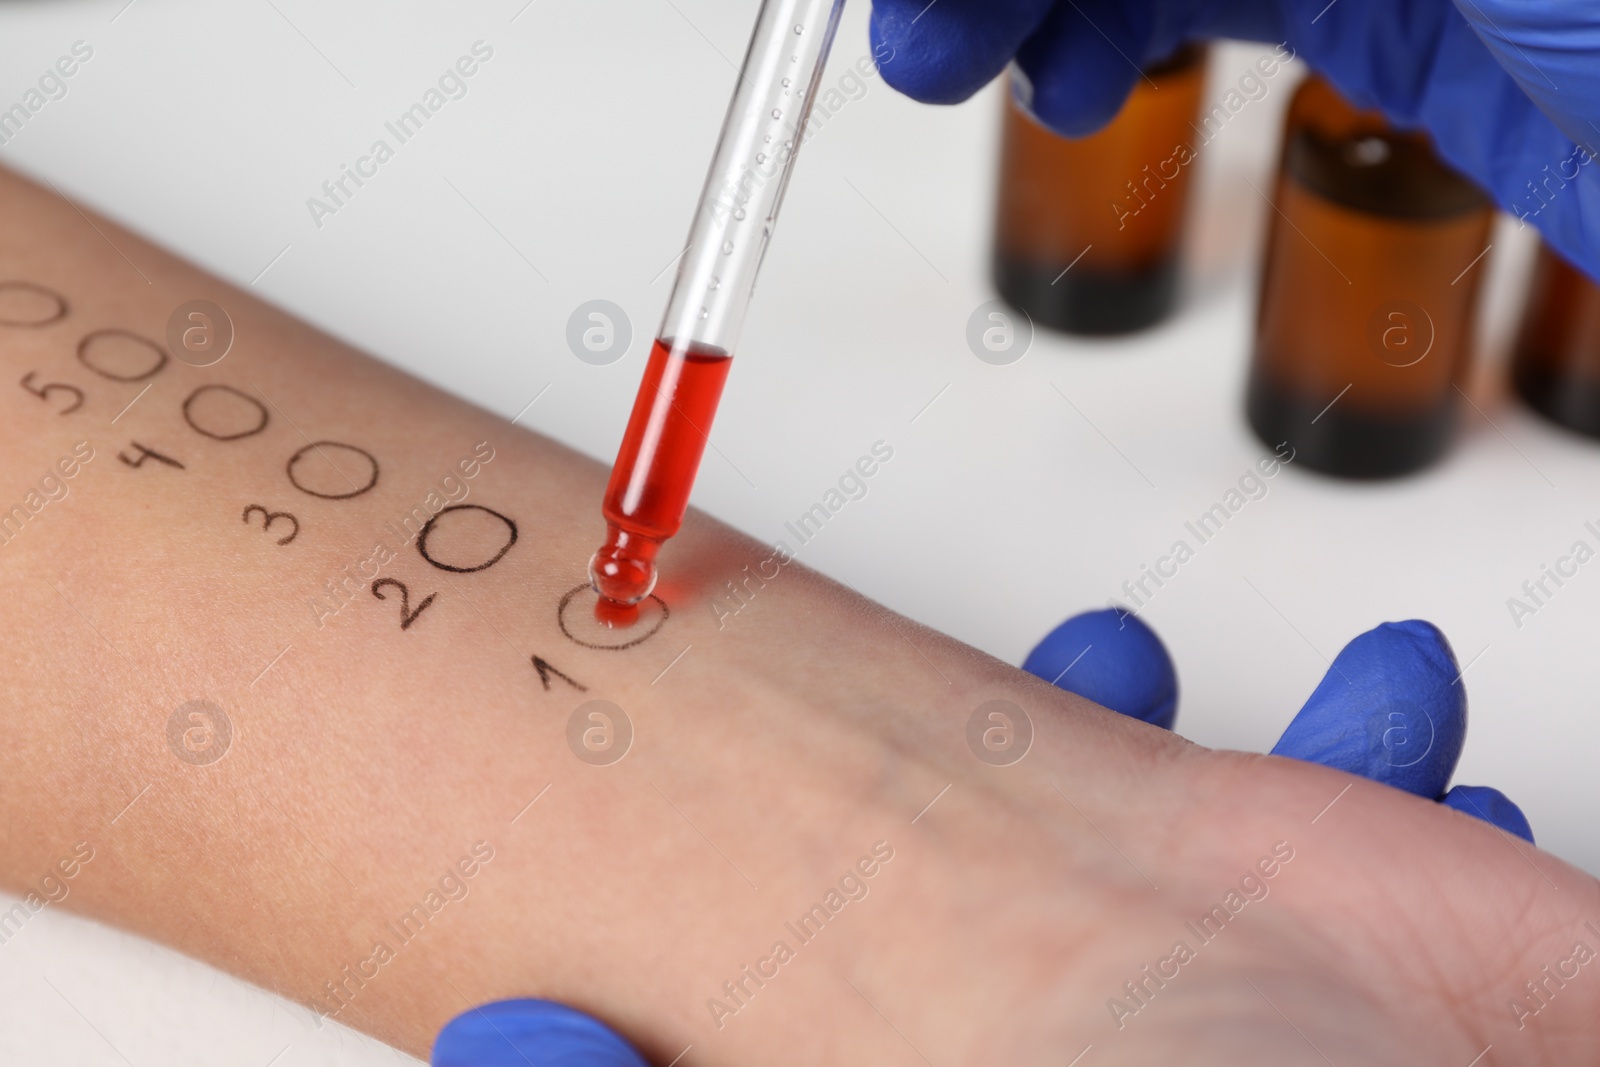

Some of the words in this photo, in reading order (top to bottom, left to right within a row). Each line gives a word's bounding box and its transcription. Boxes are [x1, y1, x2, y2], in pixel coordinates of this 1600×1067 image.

[20, 371, 84, 415] 5
[117, 441, 185, 469] 4
[242, 504, 298, 546] 3
[371, 577, 437, 630] 2
[531, 654, 589, 692] 1
